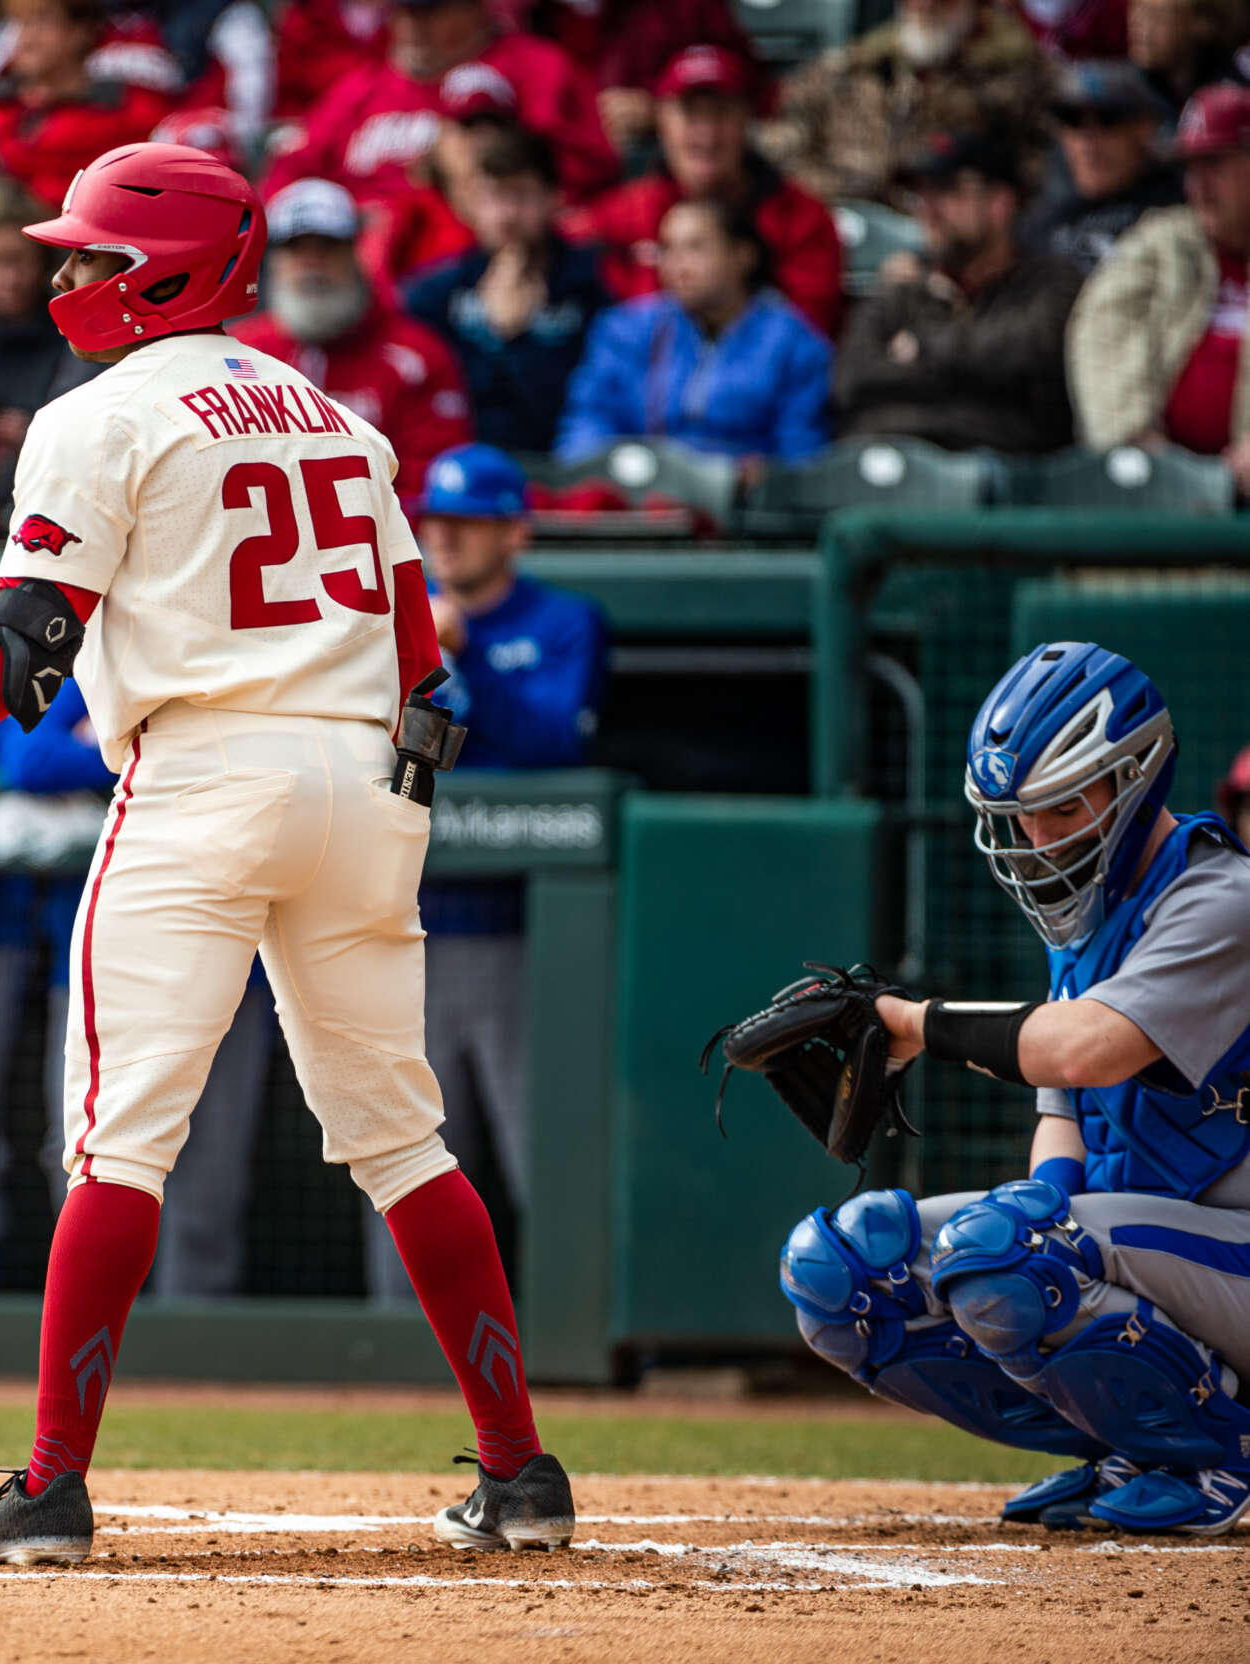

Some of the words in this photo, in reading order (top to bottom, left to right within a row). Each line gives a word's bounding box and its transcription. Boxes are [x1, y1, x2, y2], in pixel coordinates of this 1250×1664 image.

[179, 383, 353, 439] FRANKLIN
[222, 455, 391, 631] 25
[433, 798, 602, 848] Arkansas
